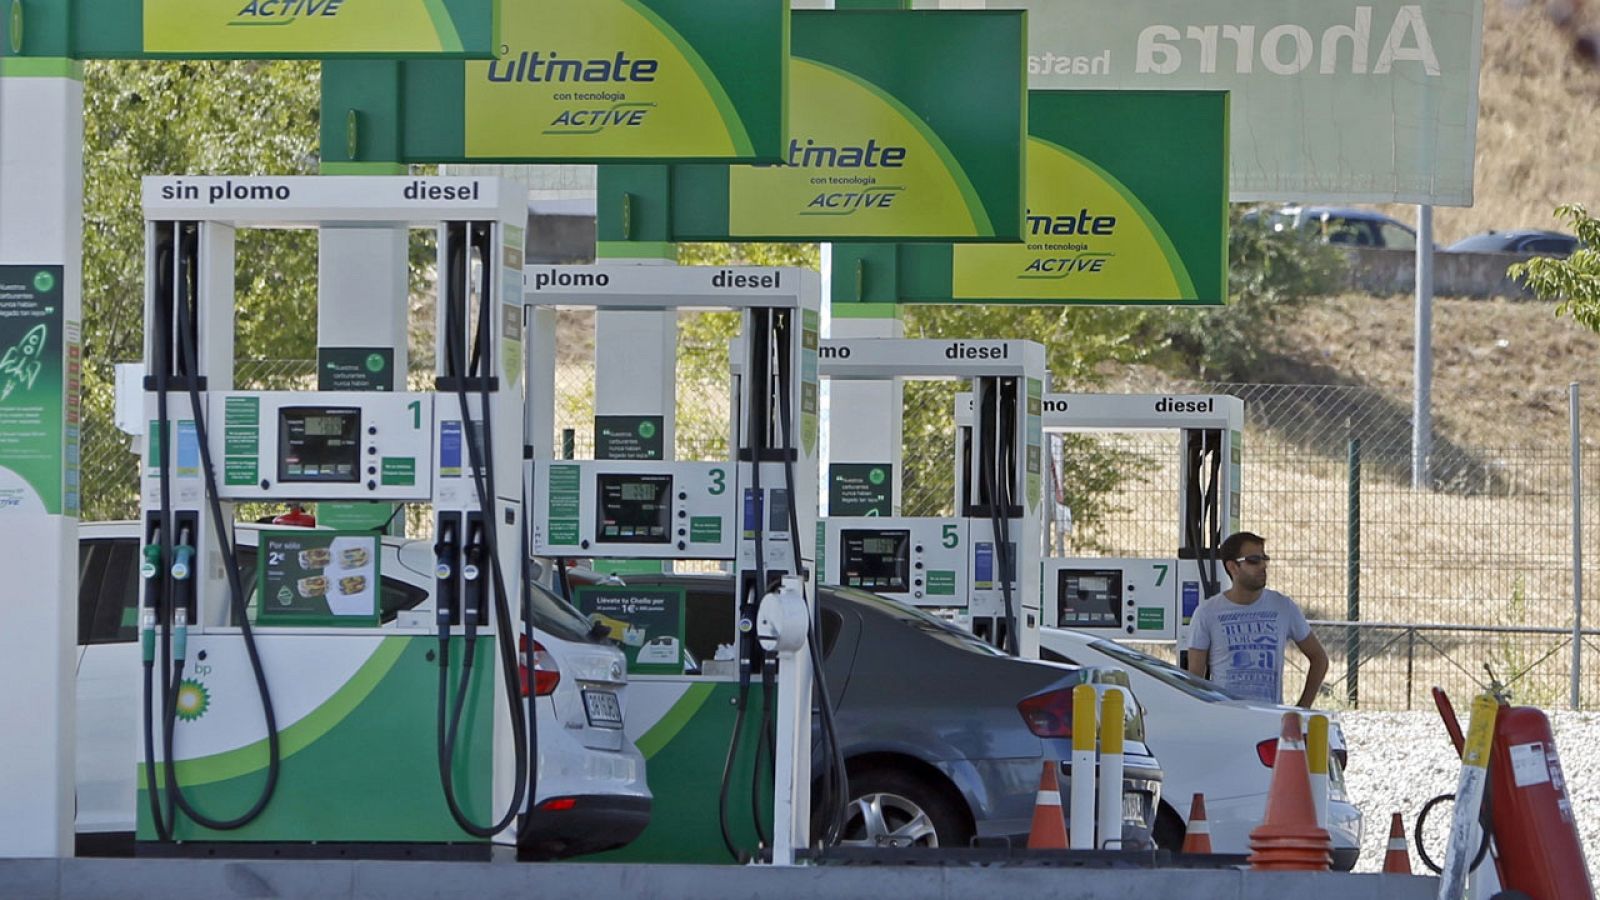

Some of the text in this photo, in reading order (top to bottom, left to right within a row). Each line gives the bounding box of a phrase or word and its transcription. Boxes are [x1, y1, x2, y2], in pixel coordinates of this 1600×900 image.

[238, 0, 345, 16] ACTIVE
[488, 51, 658, 82] ultimate
[553, 93, 572, 101] con
[551, 109, 648, 126] ACTIVE
[161, 180, 291, 204] sin plomo
[403, 180, 479, 200] diesel
[808, 193, 896, 208] ACTIVE
[1025, 258, 1106, 272] ACTIVE
[535, 269, 610, 290] plomo
[712, 270, 781, 289] diesel
[945, 342, 1009, 360] diesel
[1155, 397, 1214, 412] diesel
[407, 400, 421, 430] 1
[708, 468, 726, 495] 3
[942, 524, 959, 549] 5
[1152, 564, 1168, 587] 7
[1225, 623, 1275, 636] RULES
[194, 662, 212, 677] bp
